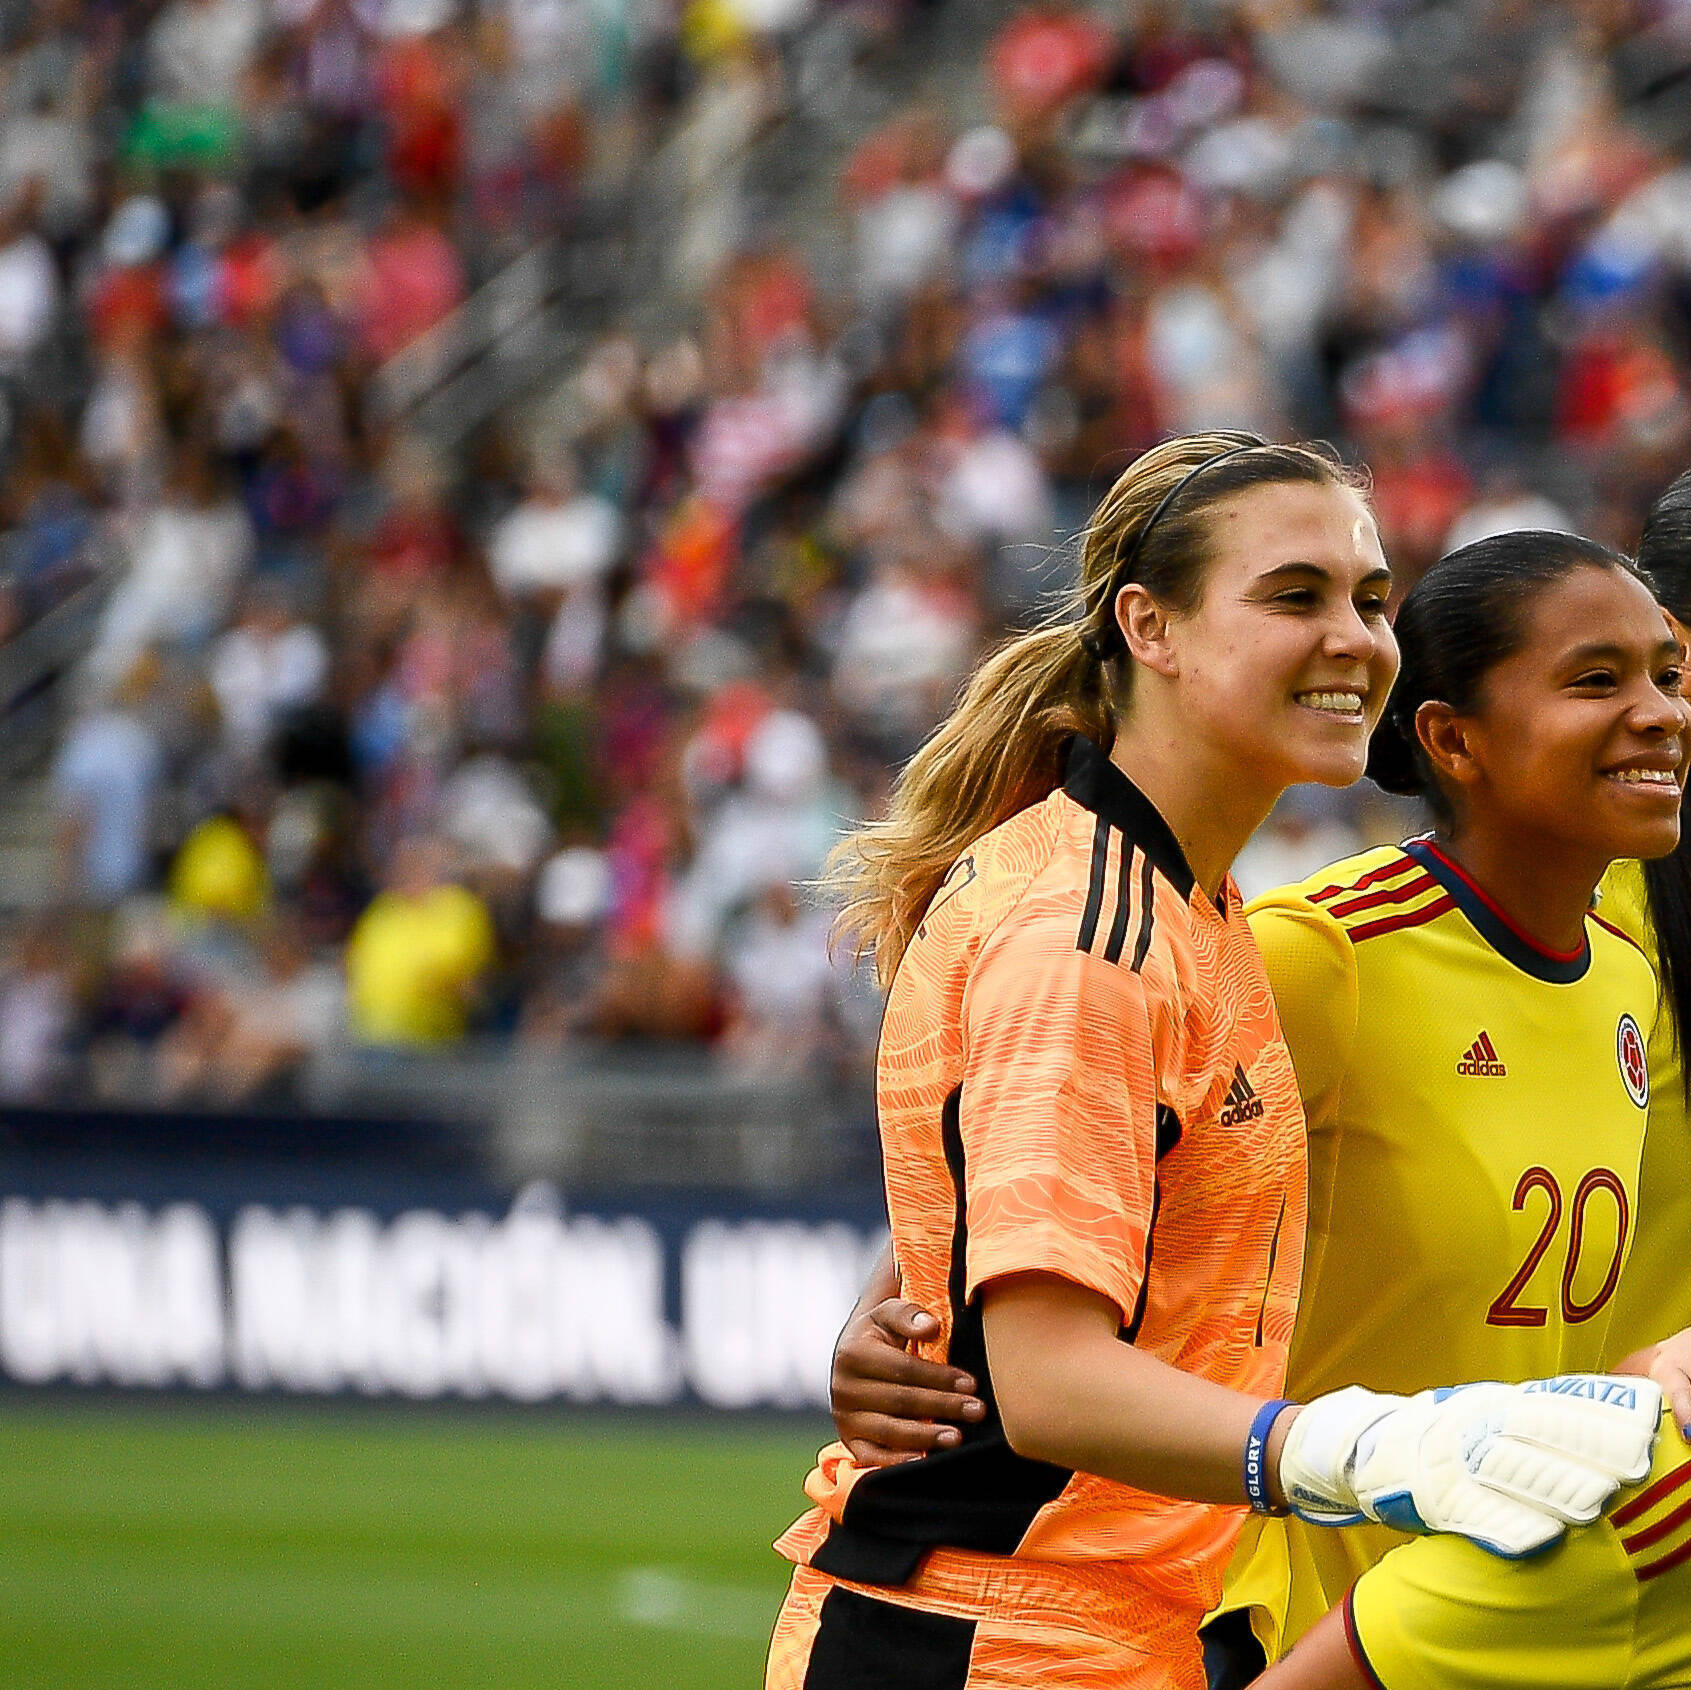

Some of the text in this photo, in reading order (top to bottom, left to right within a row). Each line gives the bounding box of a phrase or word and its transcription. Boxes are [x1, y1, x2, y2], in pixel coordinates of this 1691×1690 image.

[1457, 1058, 1507, 1077] adidas
[1220, 1098, 1264, 1128] adidas
[1486, 1166, 1630, 1326] 20
[1247, 1434, 1261, 1497] GLORY
